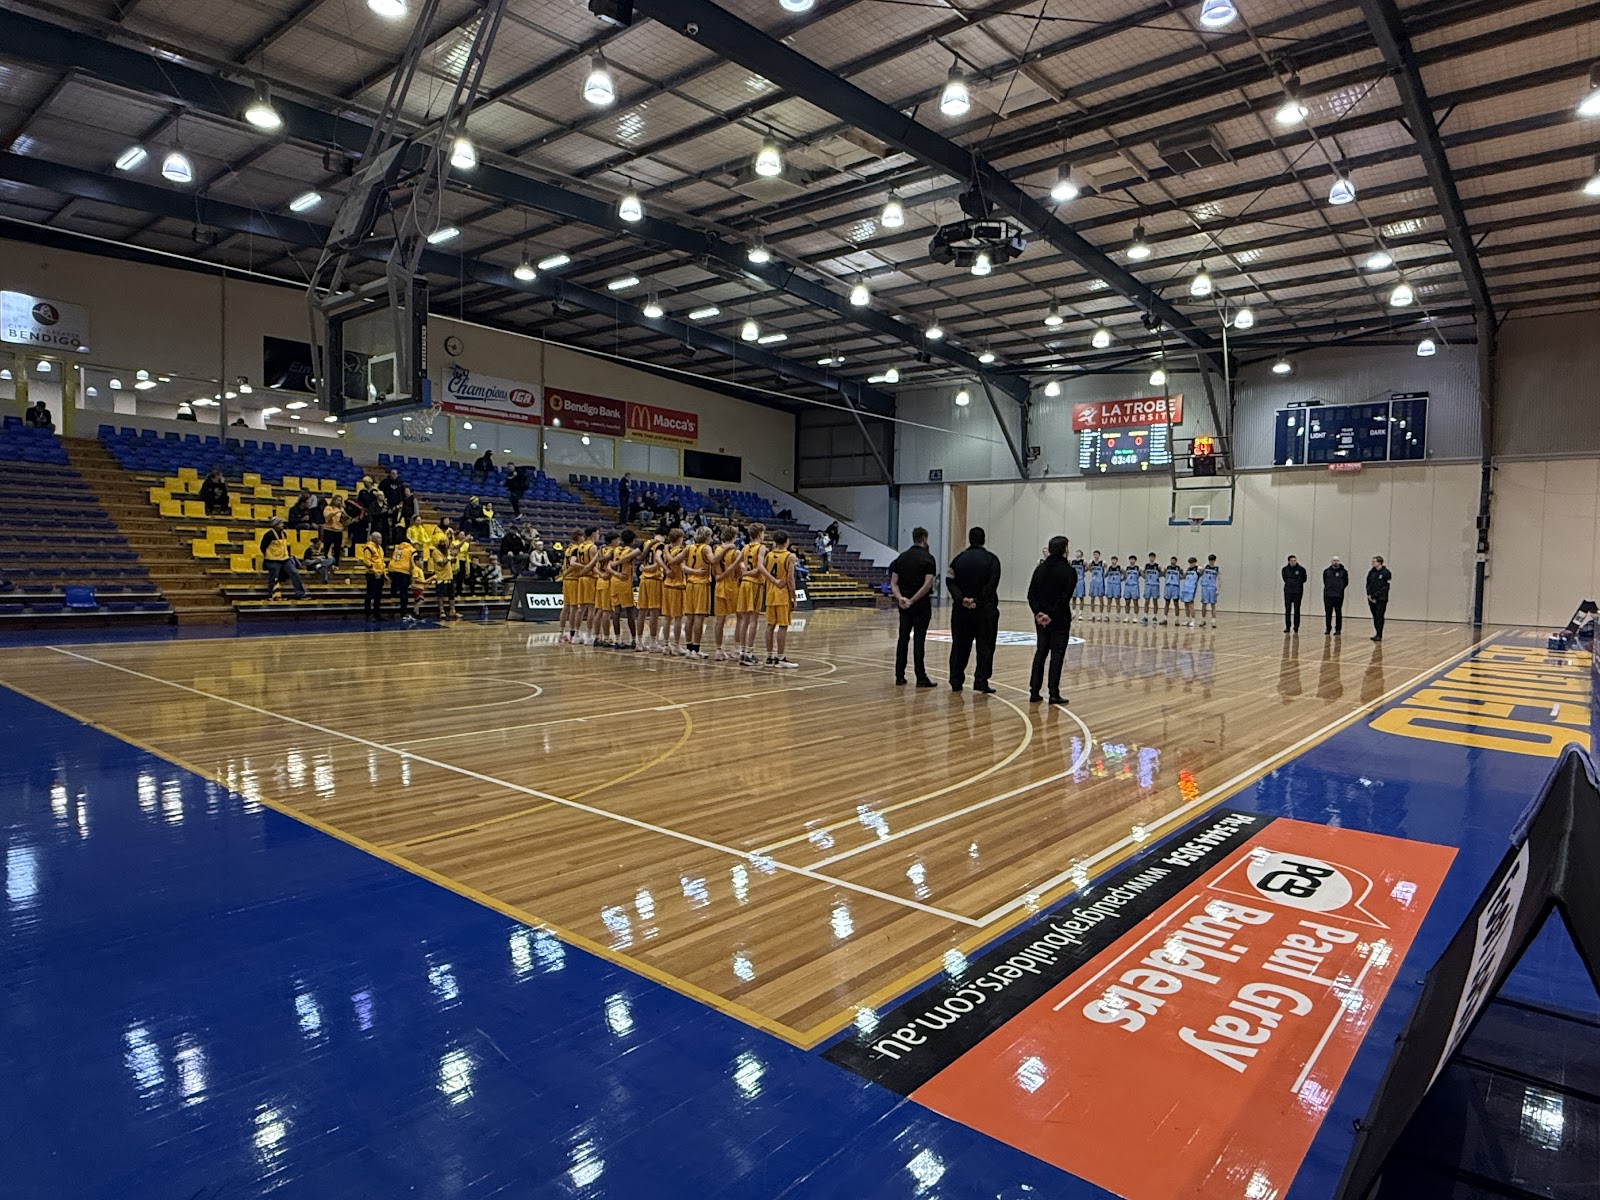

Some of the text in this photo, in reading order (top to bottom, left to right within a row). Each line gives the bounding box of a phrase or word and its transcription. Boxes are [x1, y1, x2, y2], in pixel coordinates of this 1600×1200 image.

[9, 328, 81, 347] BENDIGO
[447, 376, 508, 402] Champions
[511, 390, 532, 405] IGA
[564, 399, 621, 419] Bendigo Bank
[1101, 398, 1176, 417] LA TROBE
[653, 413, 695, 432] Macca's
[1101, 411, 1175, 425] UNIVERSITY
[771, 562, 778, 578] 4
[530, 596, 551, 606] Foot
[1161, 841, 1213, 867] 5054
[1262, 919, 1360, 987] Paul
[872, 866, 1172, 1061] www.paulgraybuilders.com.au
[1082, 899, 1275, 1033] Builders
[1178, 982, 1313, 1075] Gray
